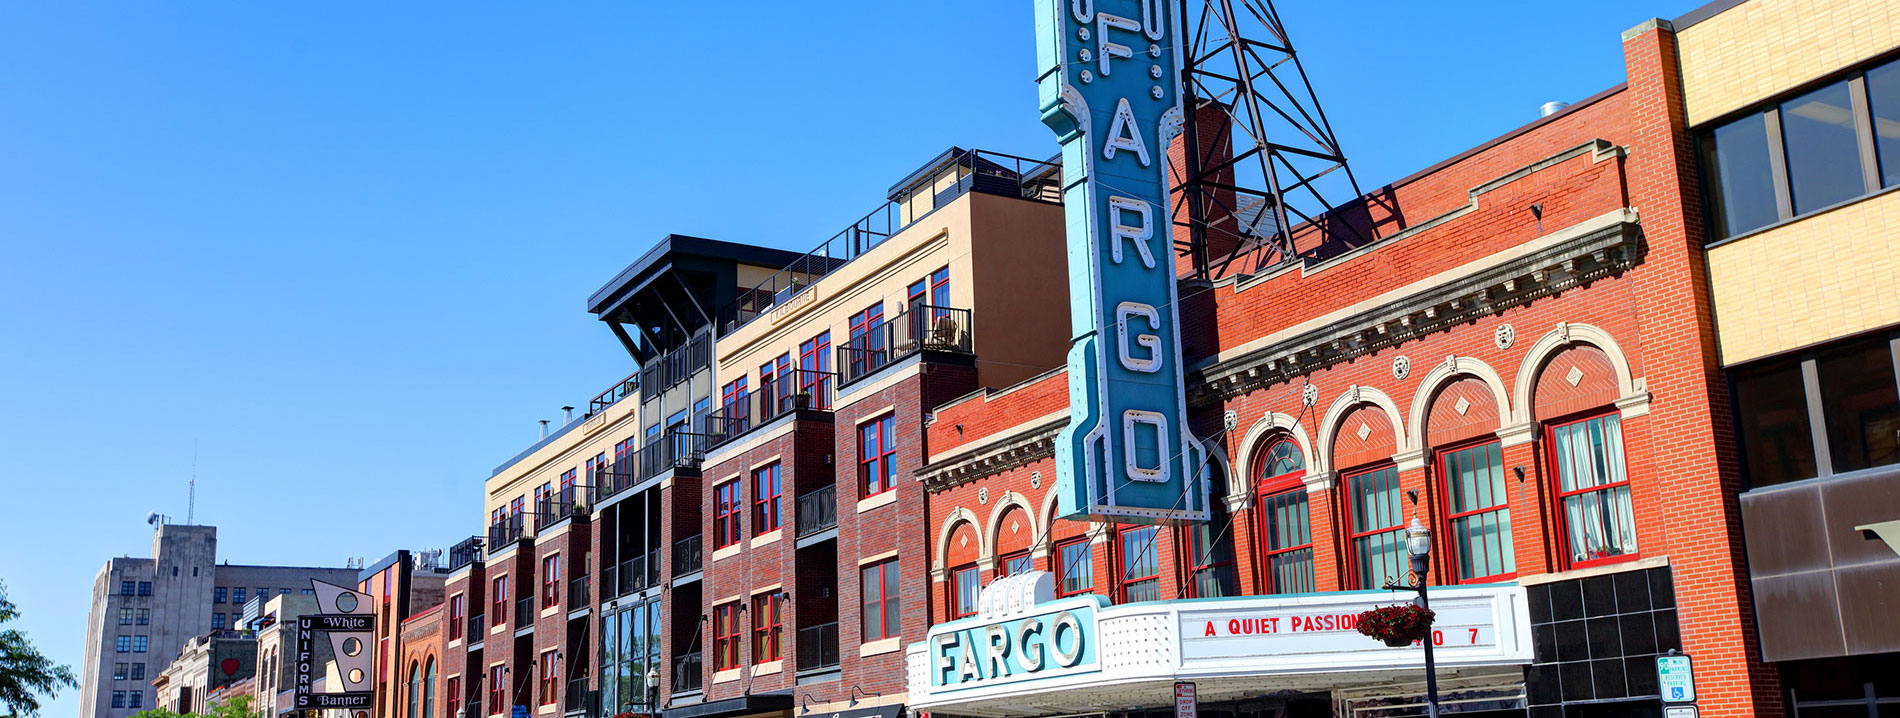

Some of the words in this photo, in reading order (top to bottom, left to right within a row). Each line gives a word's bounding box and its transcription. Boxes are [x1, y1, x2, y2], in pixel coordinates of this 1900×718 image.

[1097, 12, 1171, 483] FARGO
[323, 617, 365, 629] White
[1205, 621, 1216, 636] A
[1228, 617, 1279, 635] QUIET
[1468, 628, 1478, 644] 7
[936, 610, 1085, 685] FARGO
[298, 619, 311, 706] UNIFORMS
[317, 695, 367, 707] Banner
